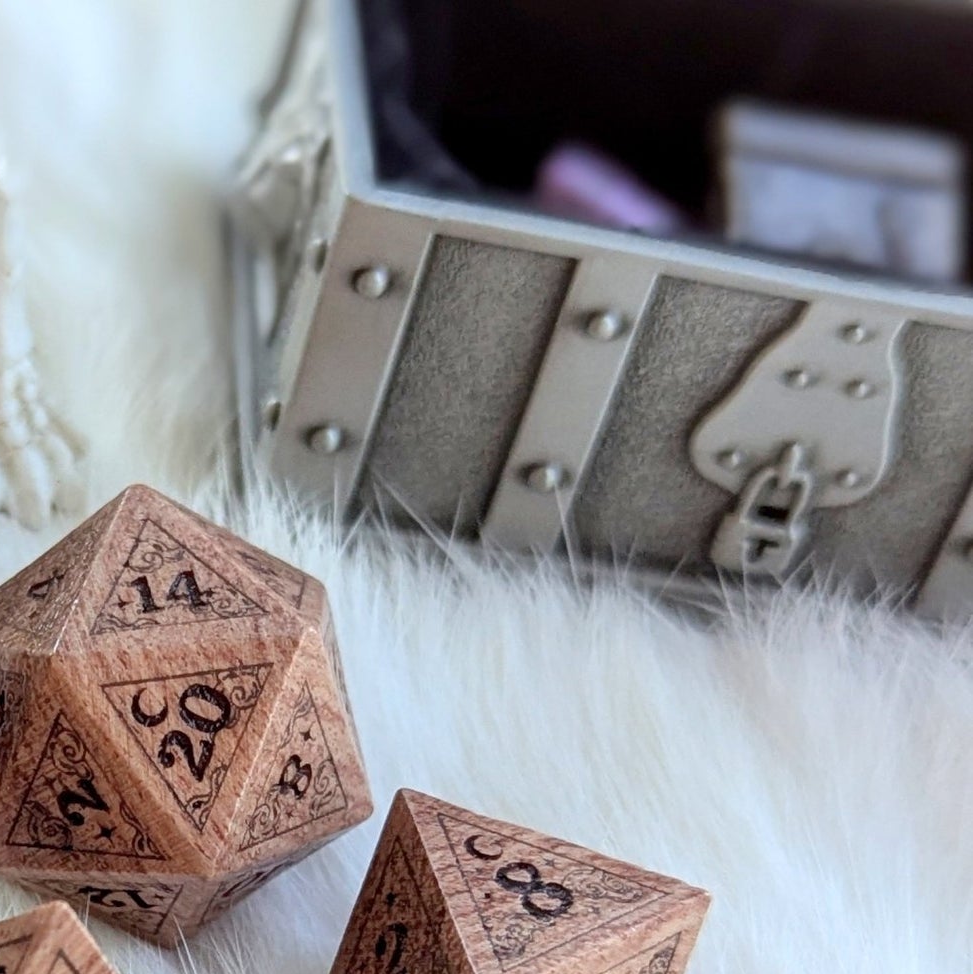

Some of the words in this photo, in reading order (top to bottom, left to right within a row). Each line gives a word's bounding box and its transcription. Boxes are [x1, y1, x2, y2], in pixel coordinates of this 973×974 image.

[128, 570, 209, 615] 14
[158, 683, 231, 781] 20
[277, 754, 313, 800] 8
[57, 778, 110, 826] 2
[496, 861, 574, 920] 8
